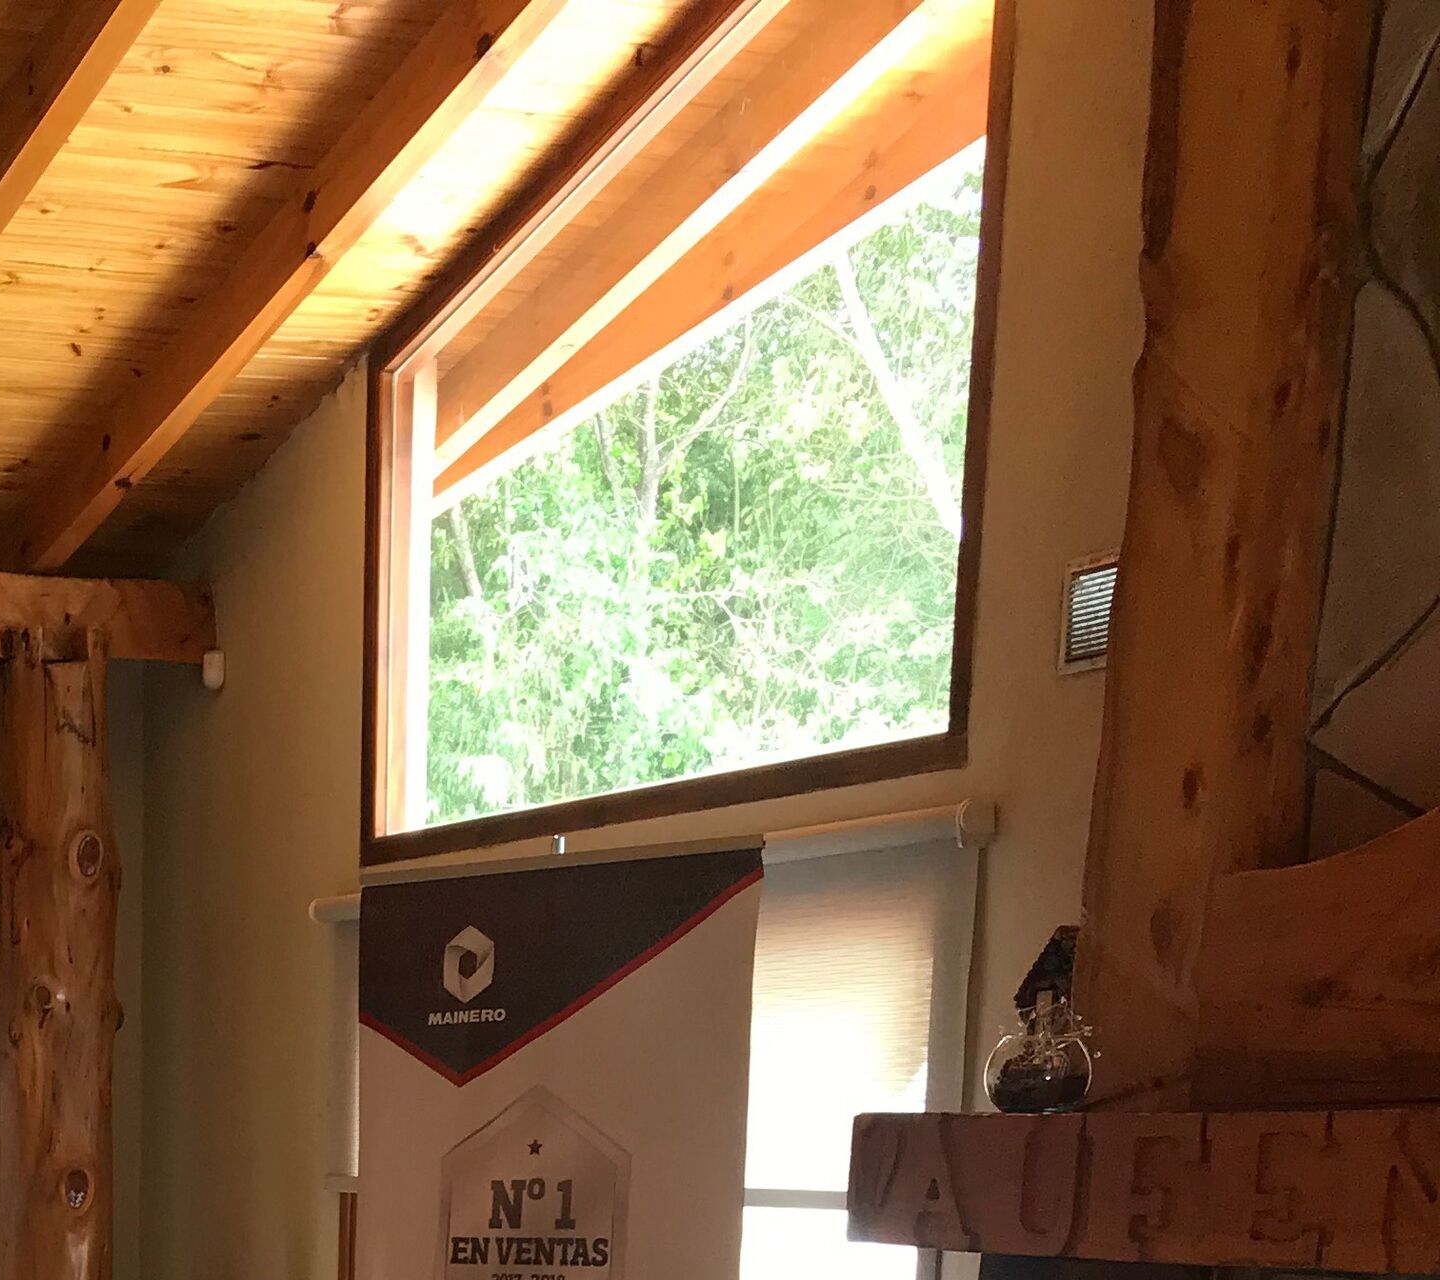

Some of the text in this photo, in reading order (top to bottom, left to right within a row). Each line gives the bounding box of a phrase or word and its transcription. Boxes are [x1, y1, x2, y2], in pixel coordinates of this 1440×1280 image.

[427, 1008, 506, 1026] MAINERO
[554, 1179, 576, 1230] 1
[450, 1237, 609, 1266] EN VENTAS
